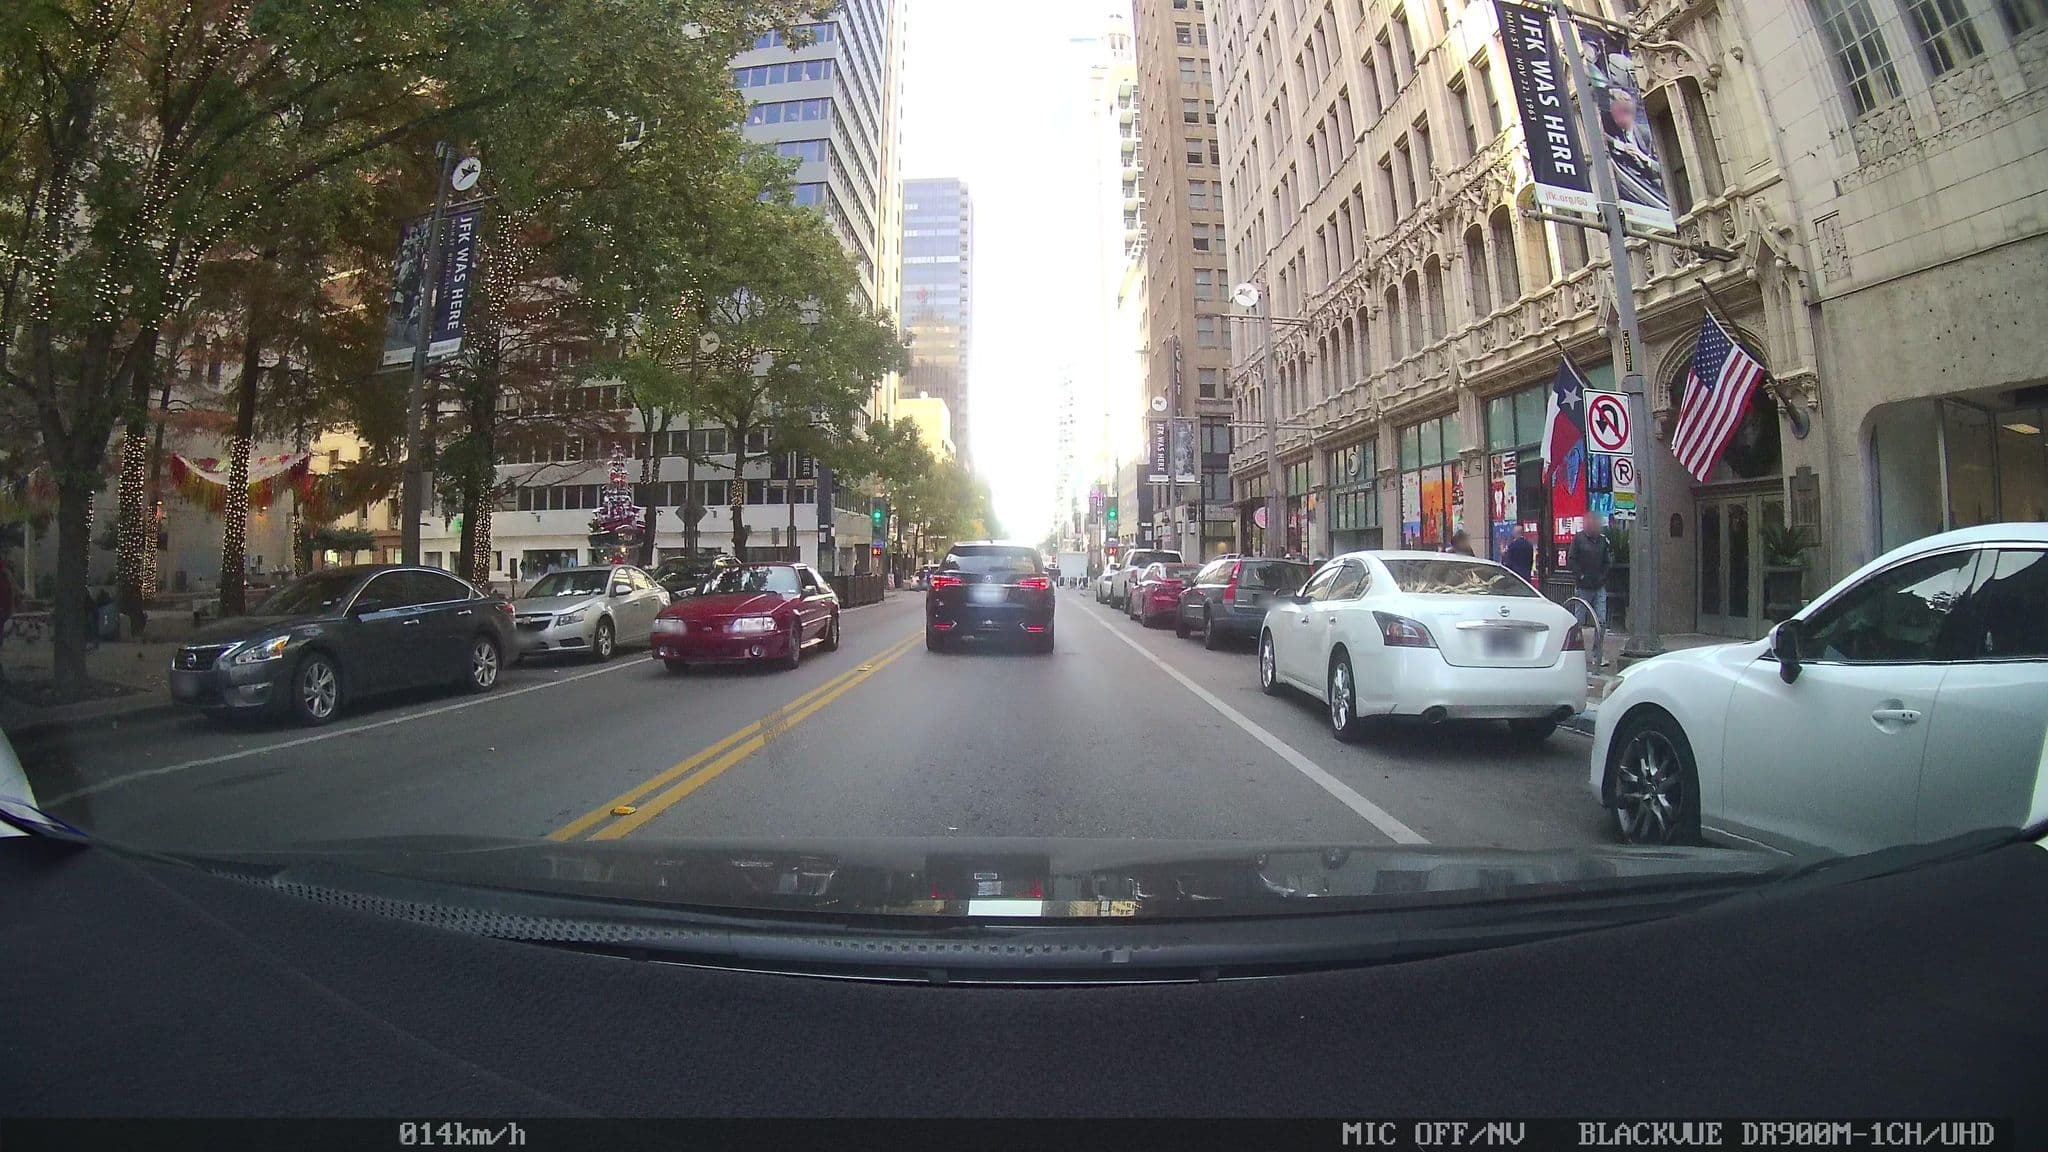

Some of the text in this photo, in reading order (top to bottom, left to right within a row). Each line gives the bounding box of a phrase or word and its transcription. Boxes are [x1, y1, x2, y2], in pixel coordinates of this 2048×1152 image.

[1505, 10, 1516, 34] MAIN
[1511, 37, 1520, 48] ST
[1515, 57, 1527, 77] NOV
[1520, 14, 1577, 176] JFK WAS HERE
[447, 217, 473, 331] JFK WAS HERE
[1156, 423, 1165, 472] JFK WAS HERE
